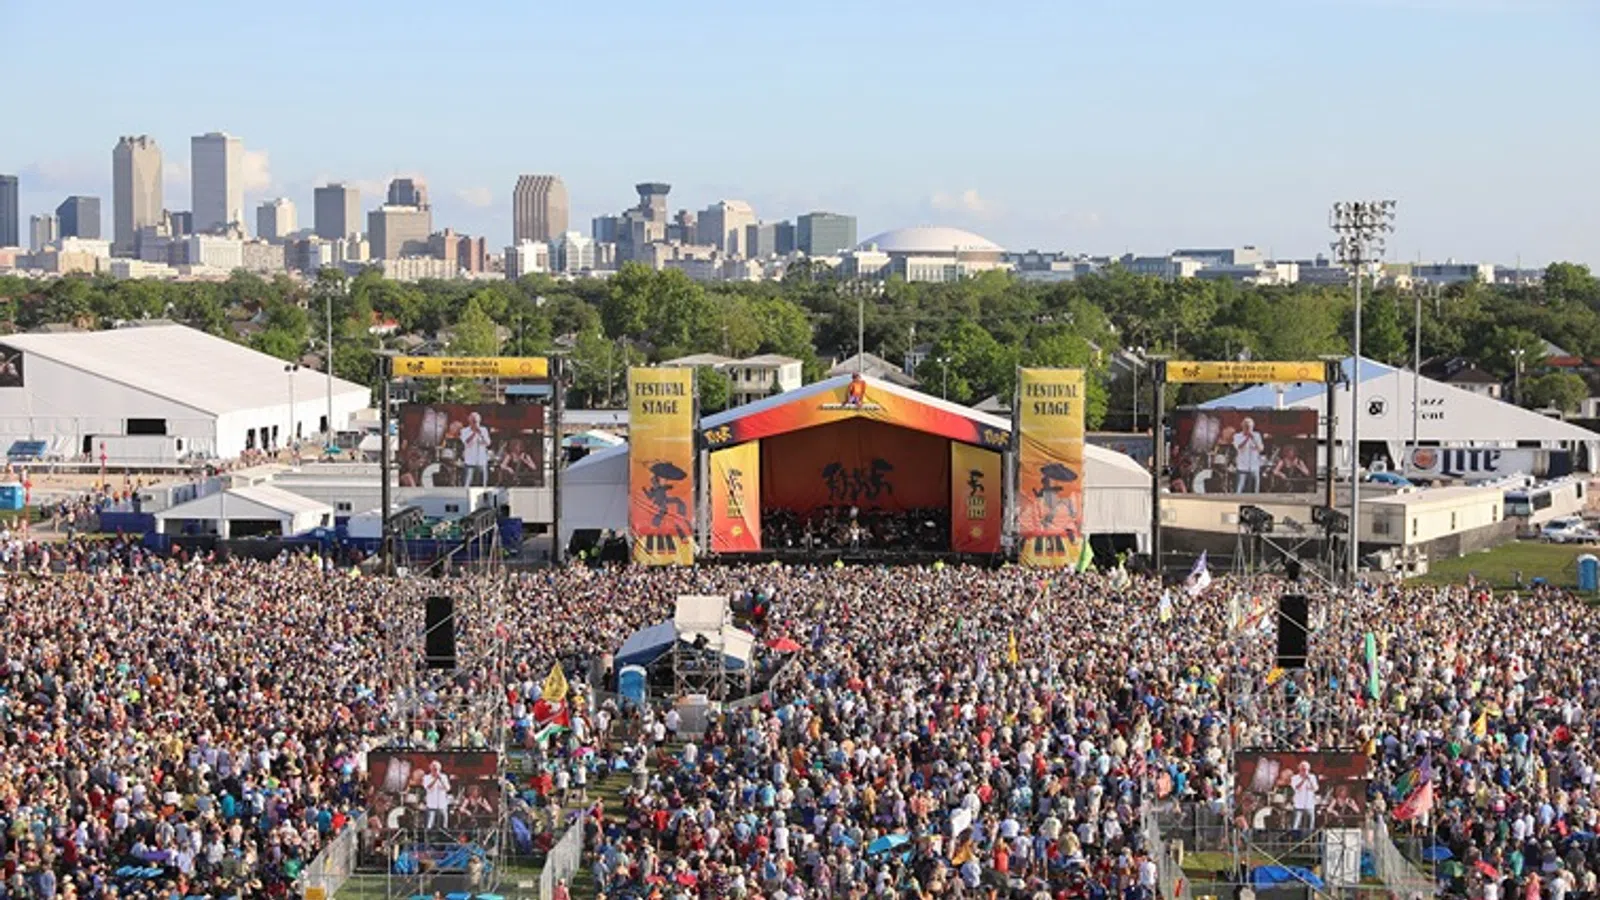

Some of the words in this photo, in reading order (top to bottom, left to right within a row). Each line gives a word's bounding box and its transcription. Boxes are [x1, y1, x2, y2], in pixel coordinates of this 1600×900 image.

[635, 382, 687, 397] FESTIVAL
[1026, 383, 1079, 398] FESTIVAL
[641, 400, 679, 415] STAGE
[1033, 401, 1070, 416] STAGE
[1412, 398, 1445, 406] azz
